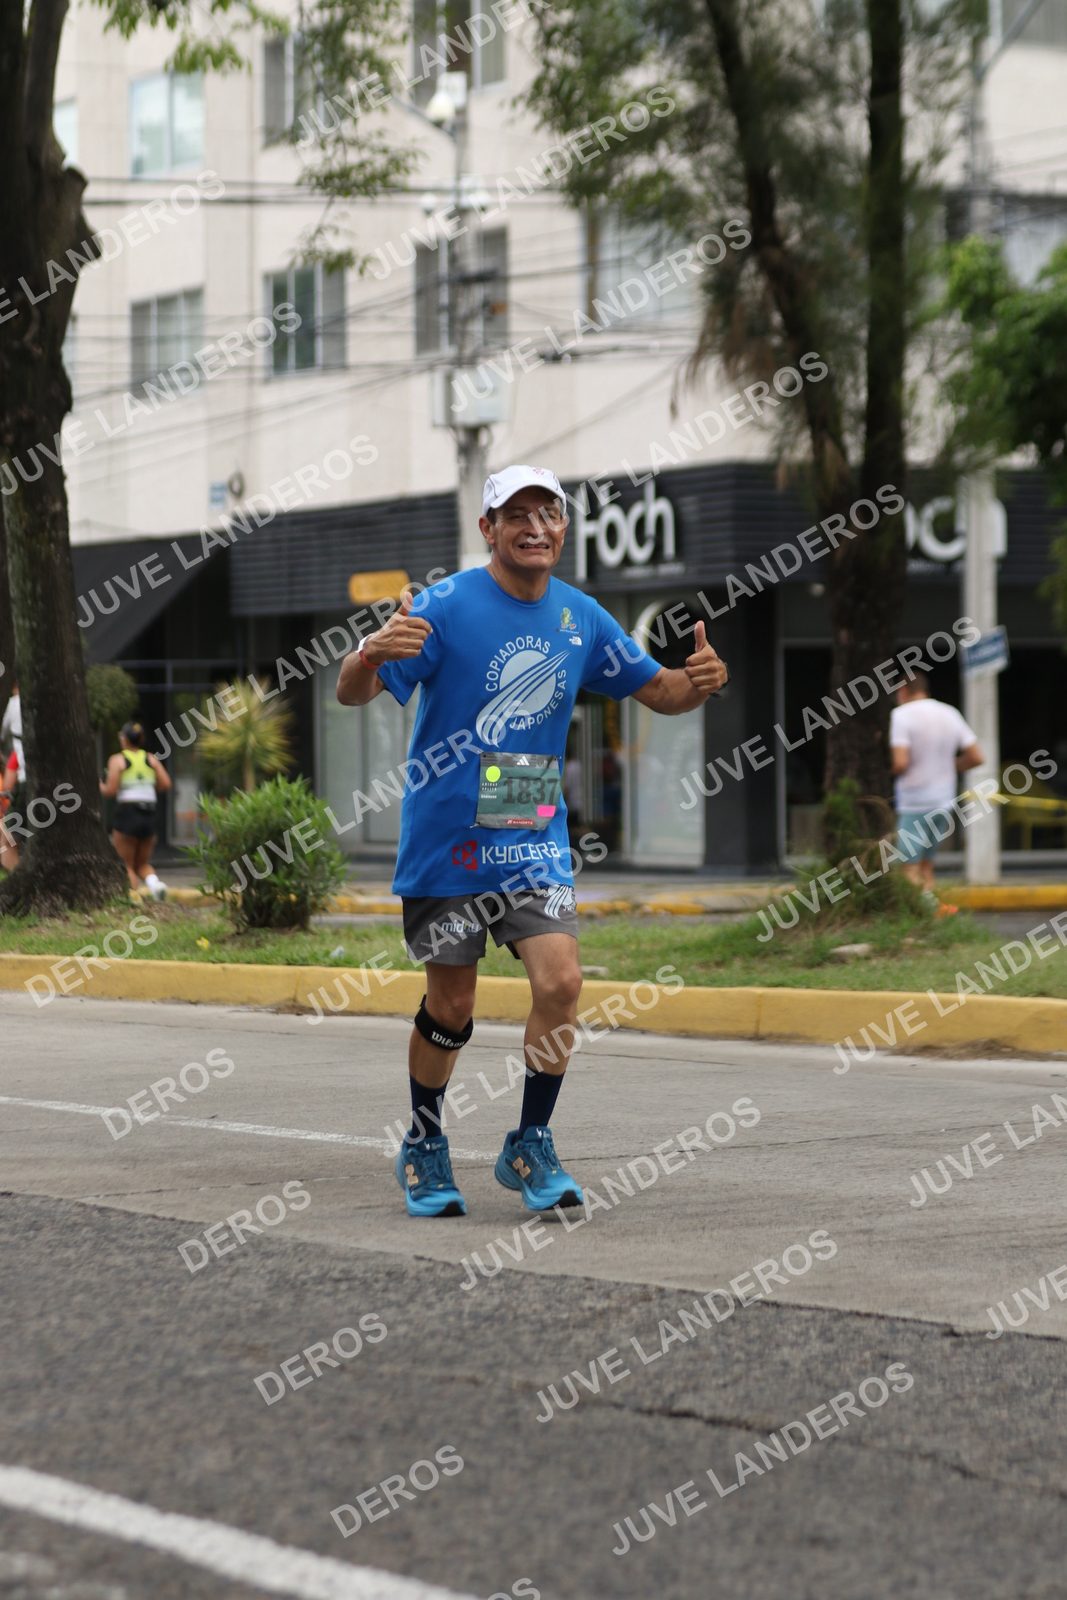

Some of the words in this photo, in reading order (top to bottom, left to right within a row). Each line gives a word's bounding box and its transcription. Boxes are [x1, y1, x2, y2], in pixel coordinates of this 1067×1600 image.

[575, 477, 676, 581] Foch
[485, 635, 551, 692] COPIADORAS
[509, 669, 567, 731] JAPONESAS
[502, 776, 558, 804] 1837
[481, 841, 561, 865] KYOCERA
[431, 1031, 465, 1047] Wilson
